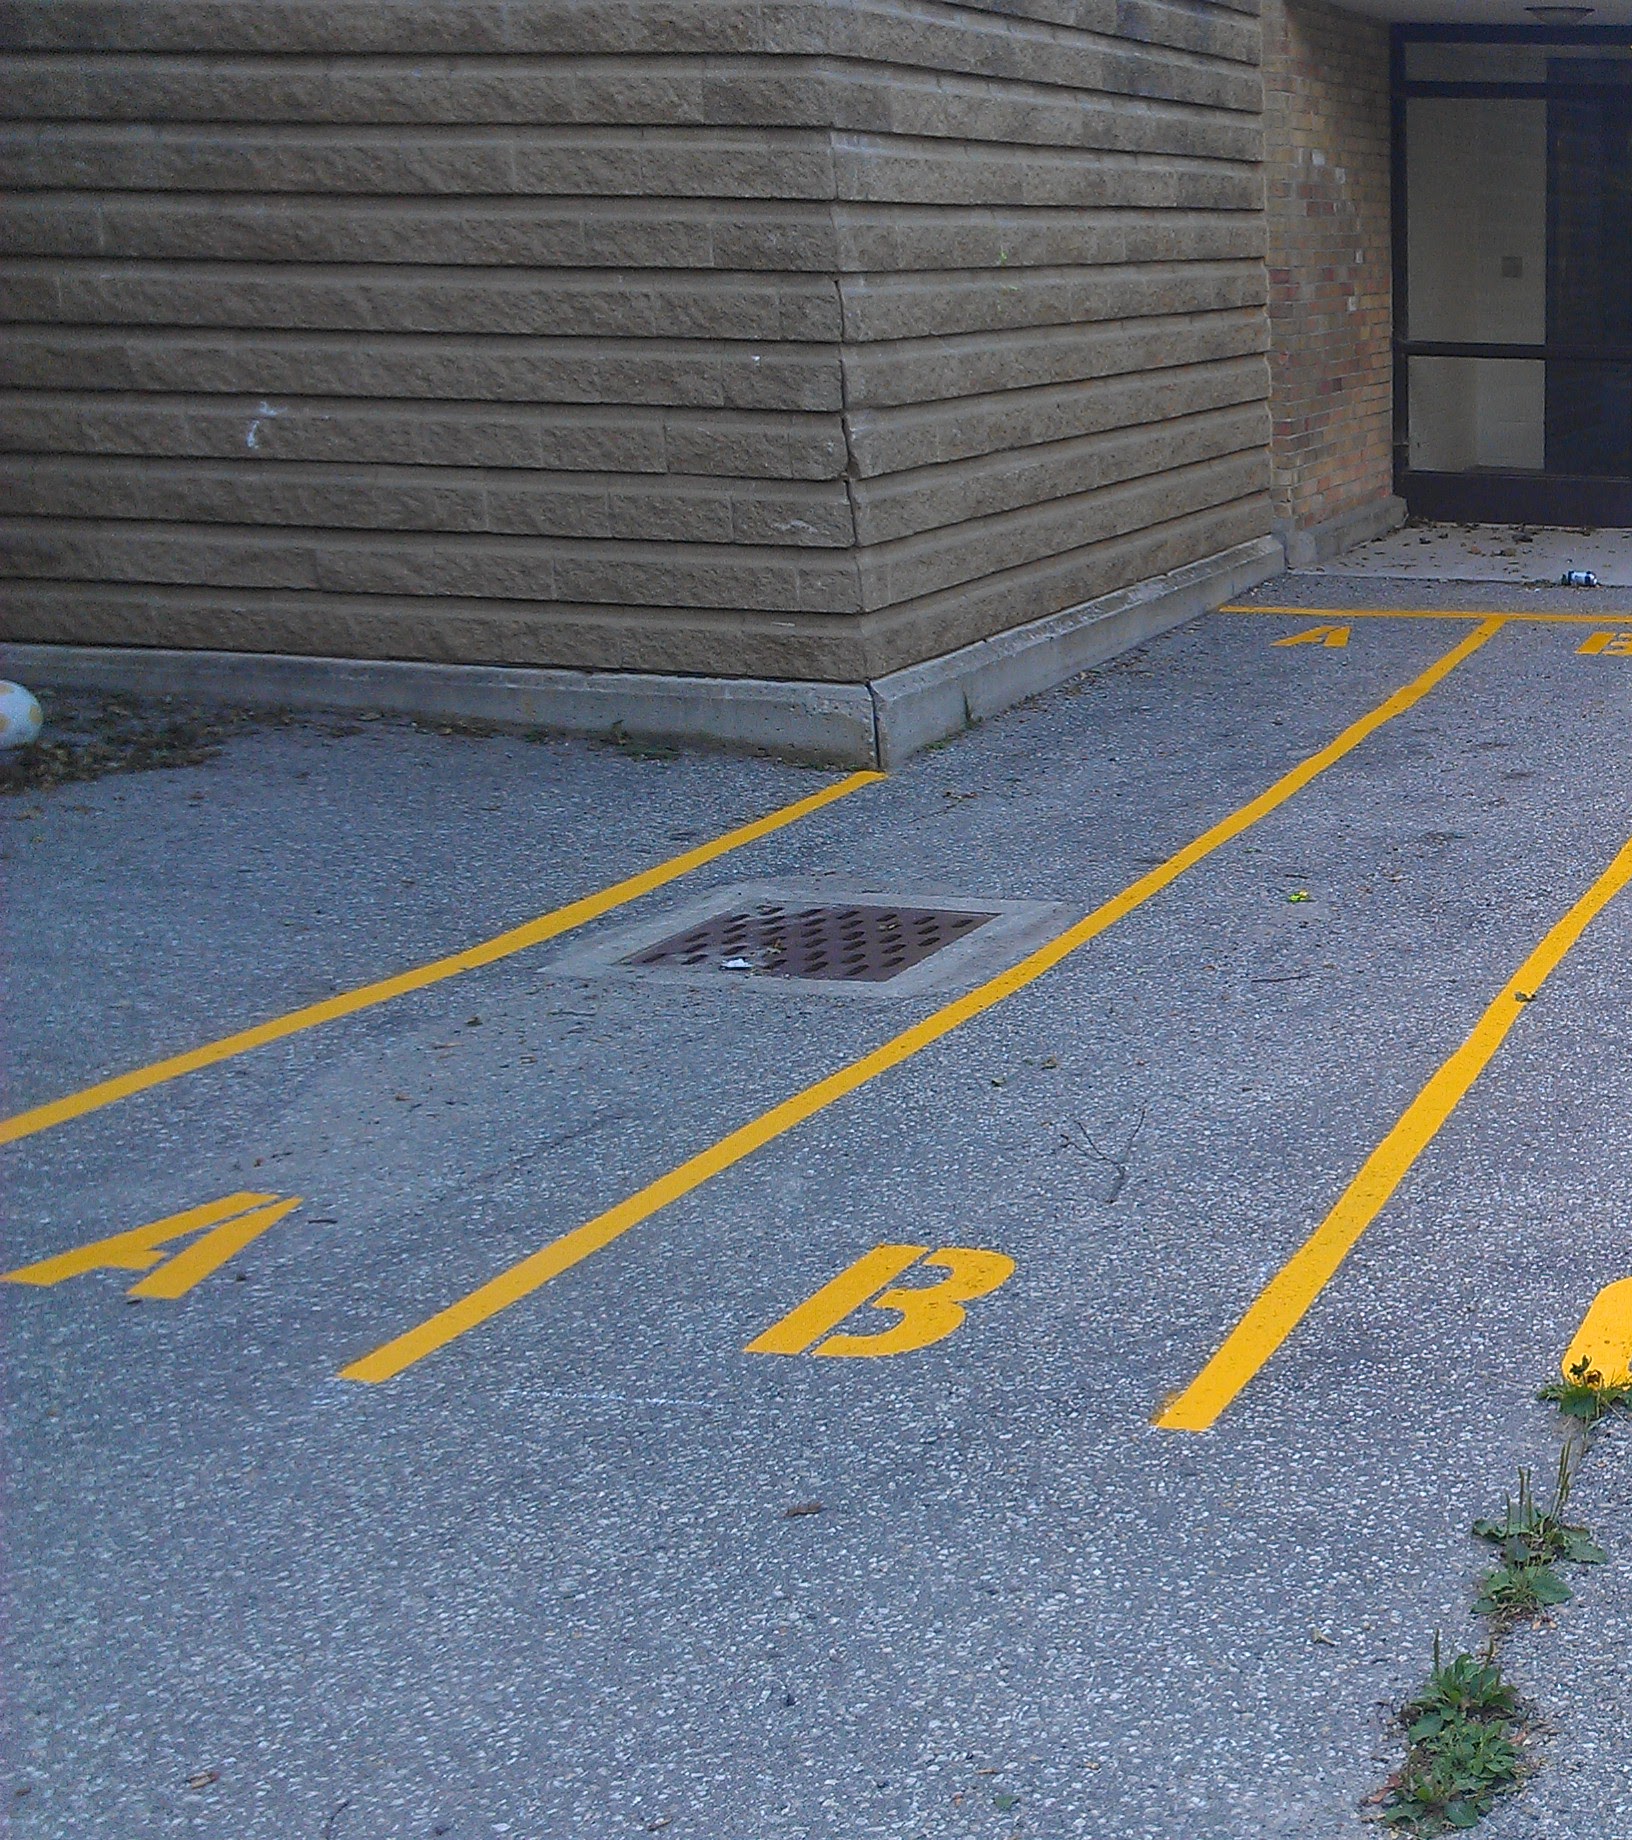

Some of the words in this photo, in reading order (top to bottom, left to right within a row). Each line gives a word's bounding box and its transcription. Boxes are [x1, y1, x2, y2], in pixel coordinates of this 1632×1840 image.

[1269, 625, 1351, 648] A
[0, 1192, 302, 1299] A
[743, 1243, 1016, 1358] B
